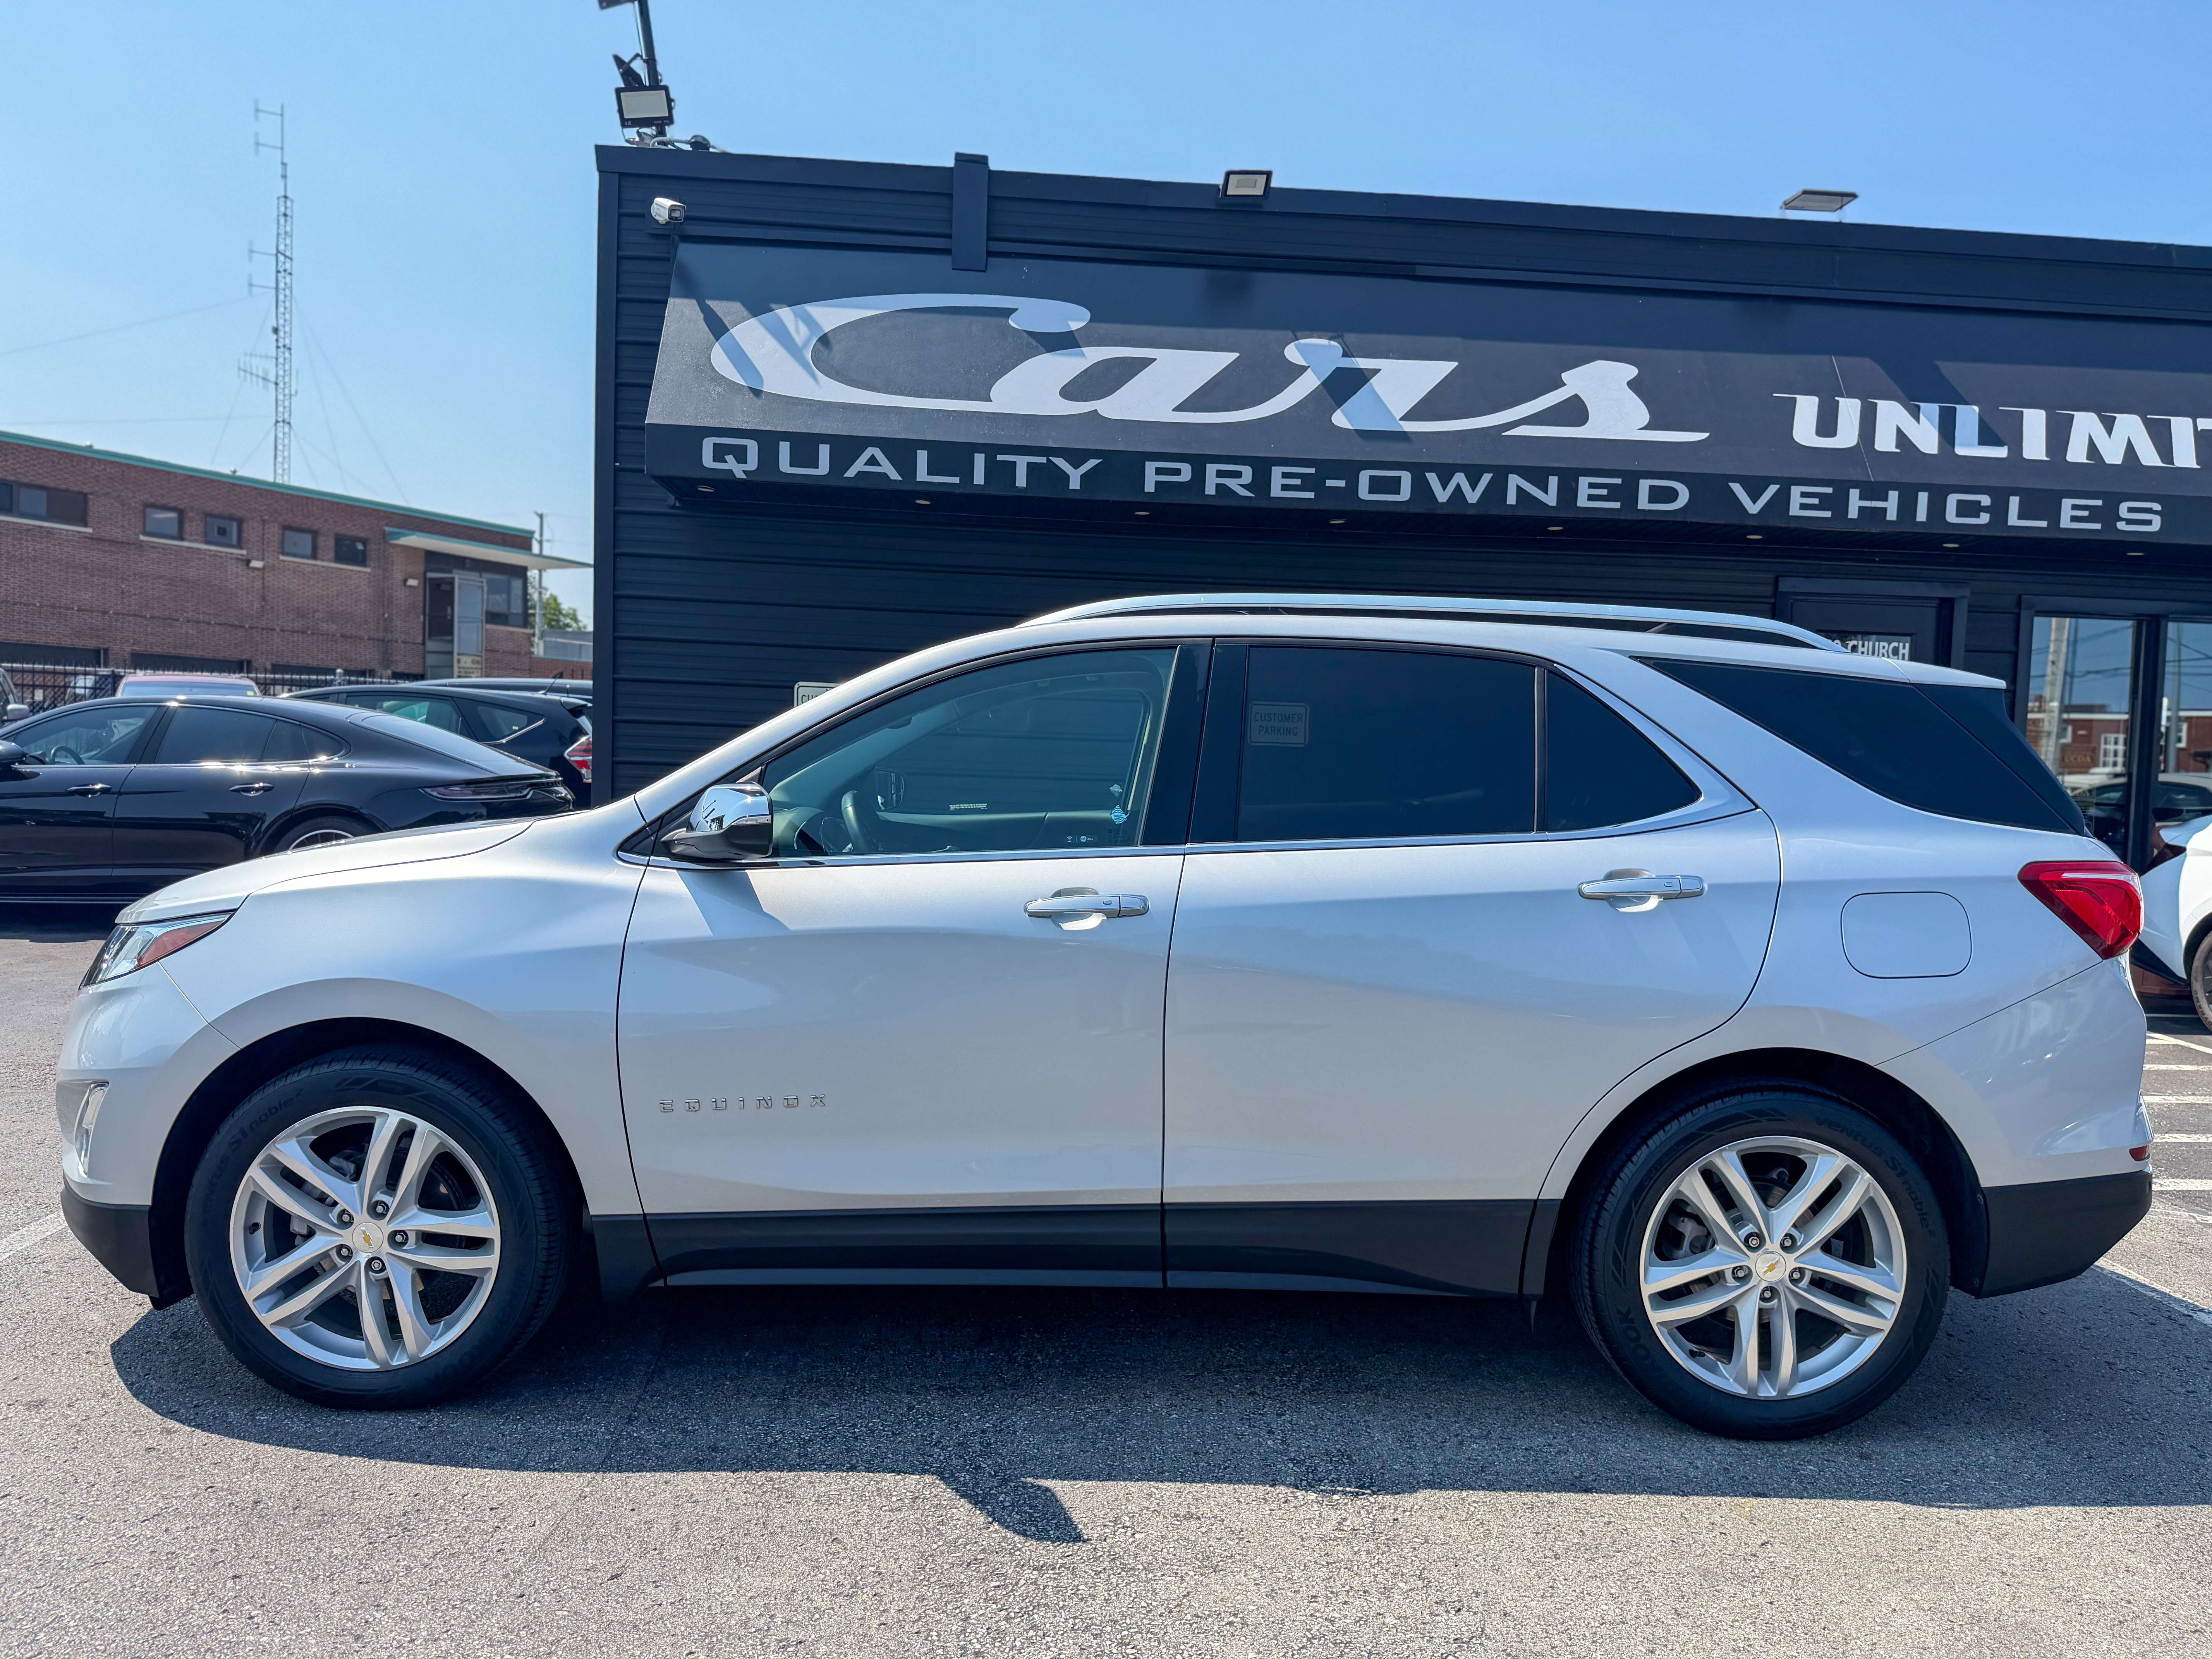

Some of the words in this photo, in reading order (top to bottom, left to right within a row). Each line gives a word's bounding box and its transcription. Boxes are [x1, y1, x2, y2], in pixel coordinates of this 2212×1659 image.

[711, 293, 1709, 442] Cars
[702, 437, 1103, 489] QUALITY
[1144, 461, 1690, 511] PRE-OWNED
[1728, 483, 2162, 532] VEHICLES
[1847, 640, 1910, 661] CHURCH
[1254, 712, 1303, 723] CUSTOMER
[1259, 725, 1298, 736] PARKING
[659, 1094, 826, 1113] EQUINOX
